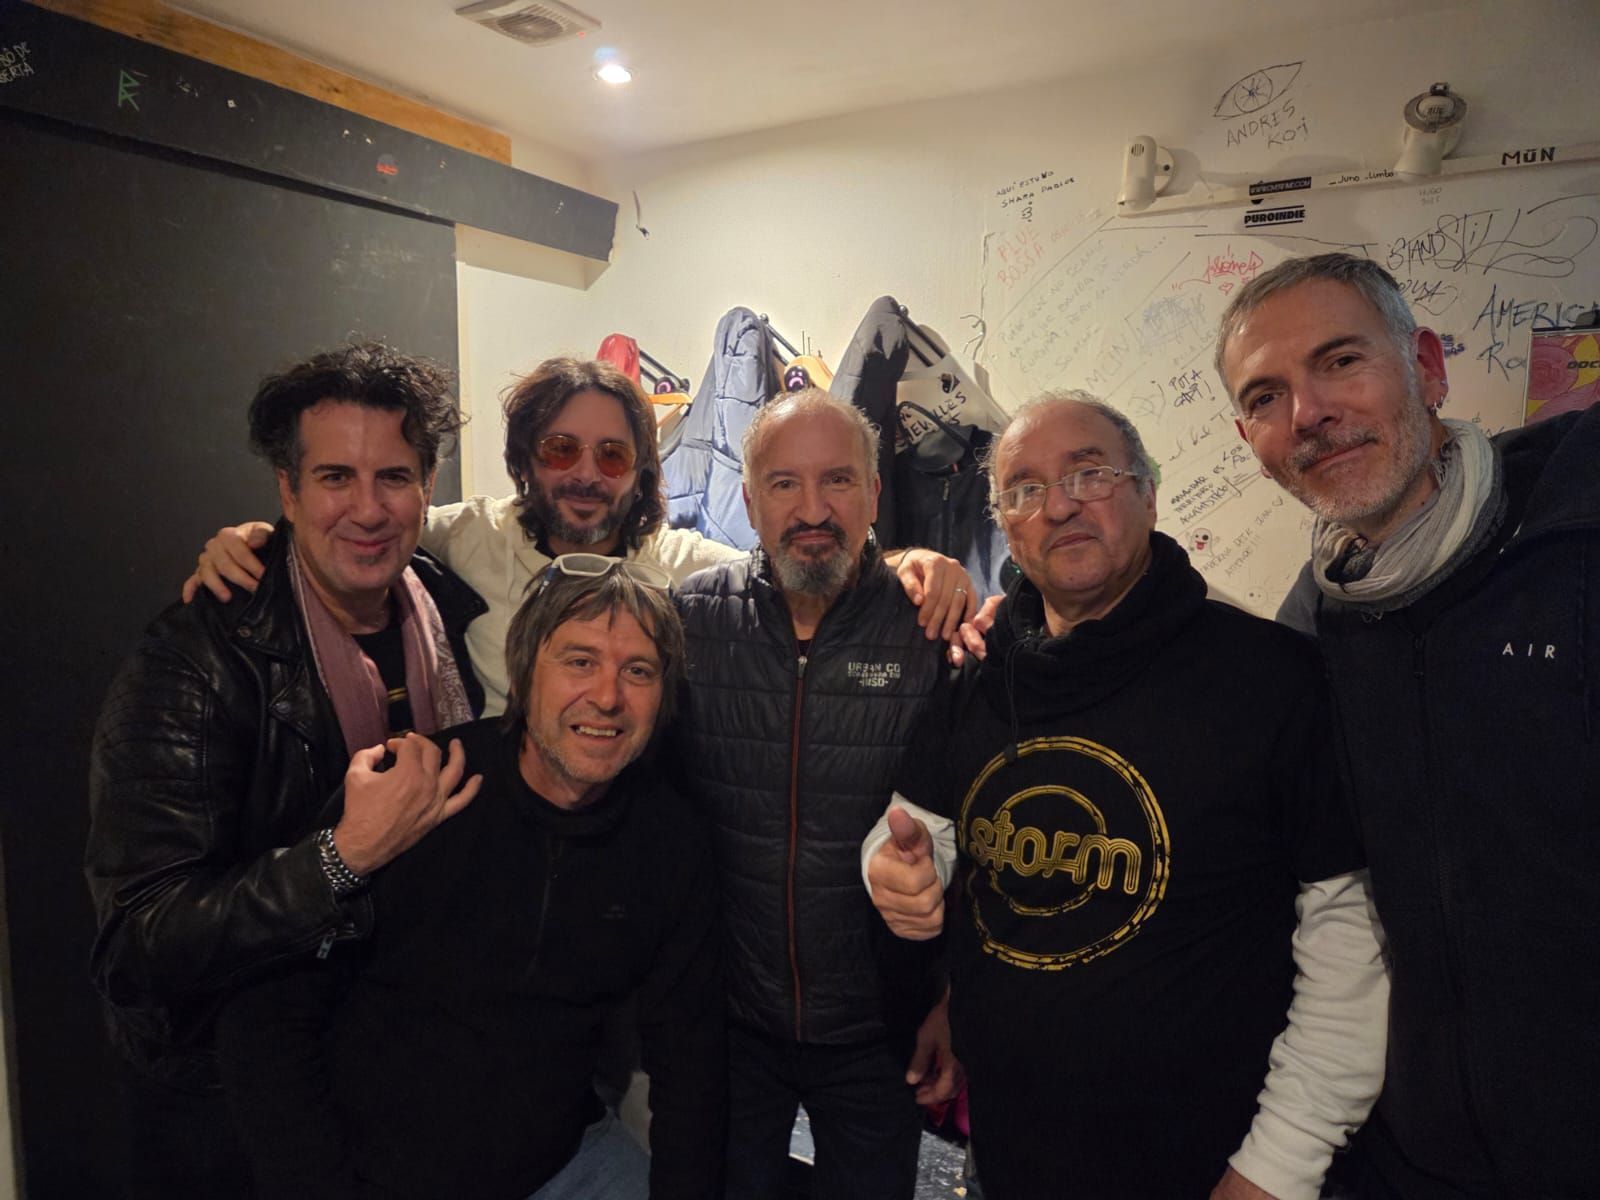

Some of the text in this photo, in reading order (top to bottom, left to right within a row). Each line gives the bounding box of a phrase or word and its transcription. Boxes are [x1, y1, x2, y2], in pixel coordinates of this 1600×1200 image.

[1244, 209, 1306, 224] PUROINDIE
[1502, 642, 1556, 659] AIR
[969, 810, 1142, 895] storm
